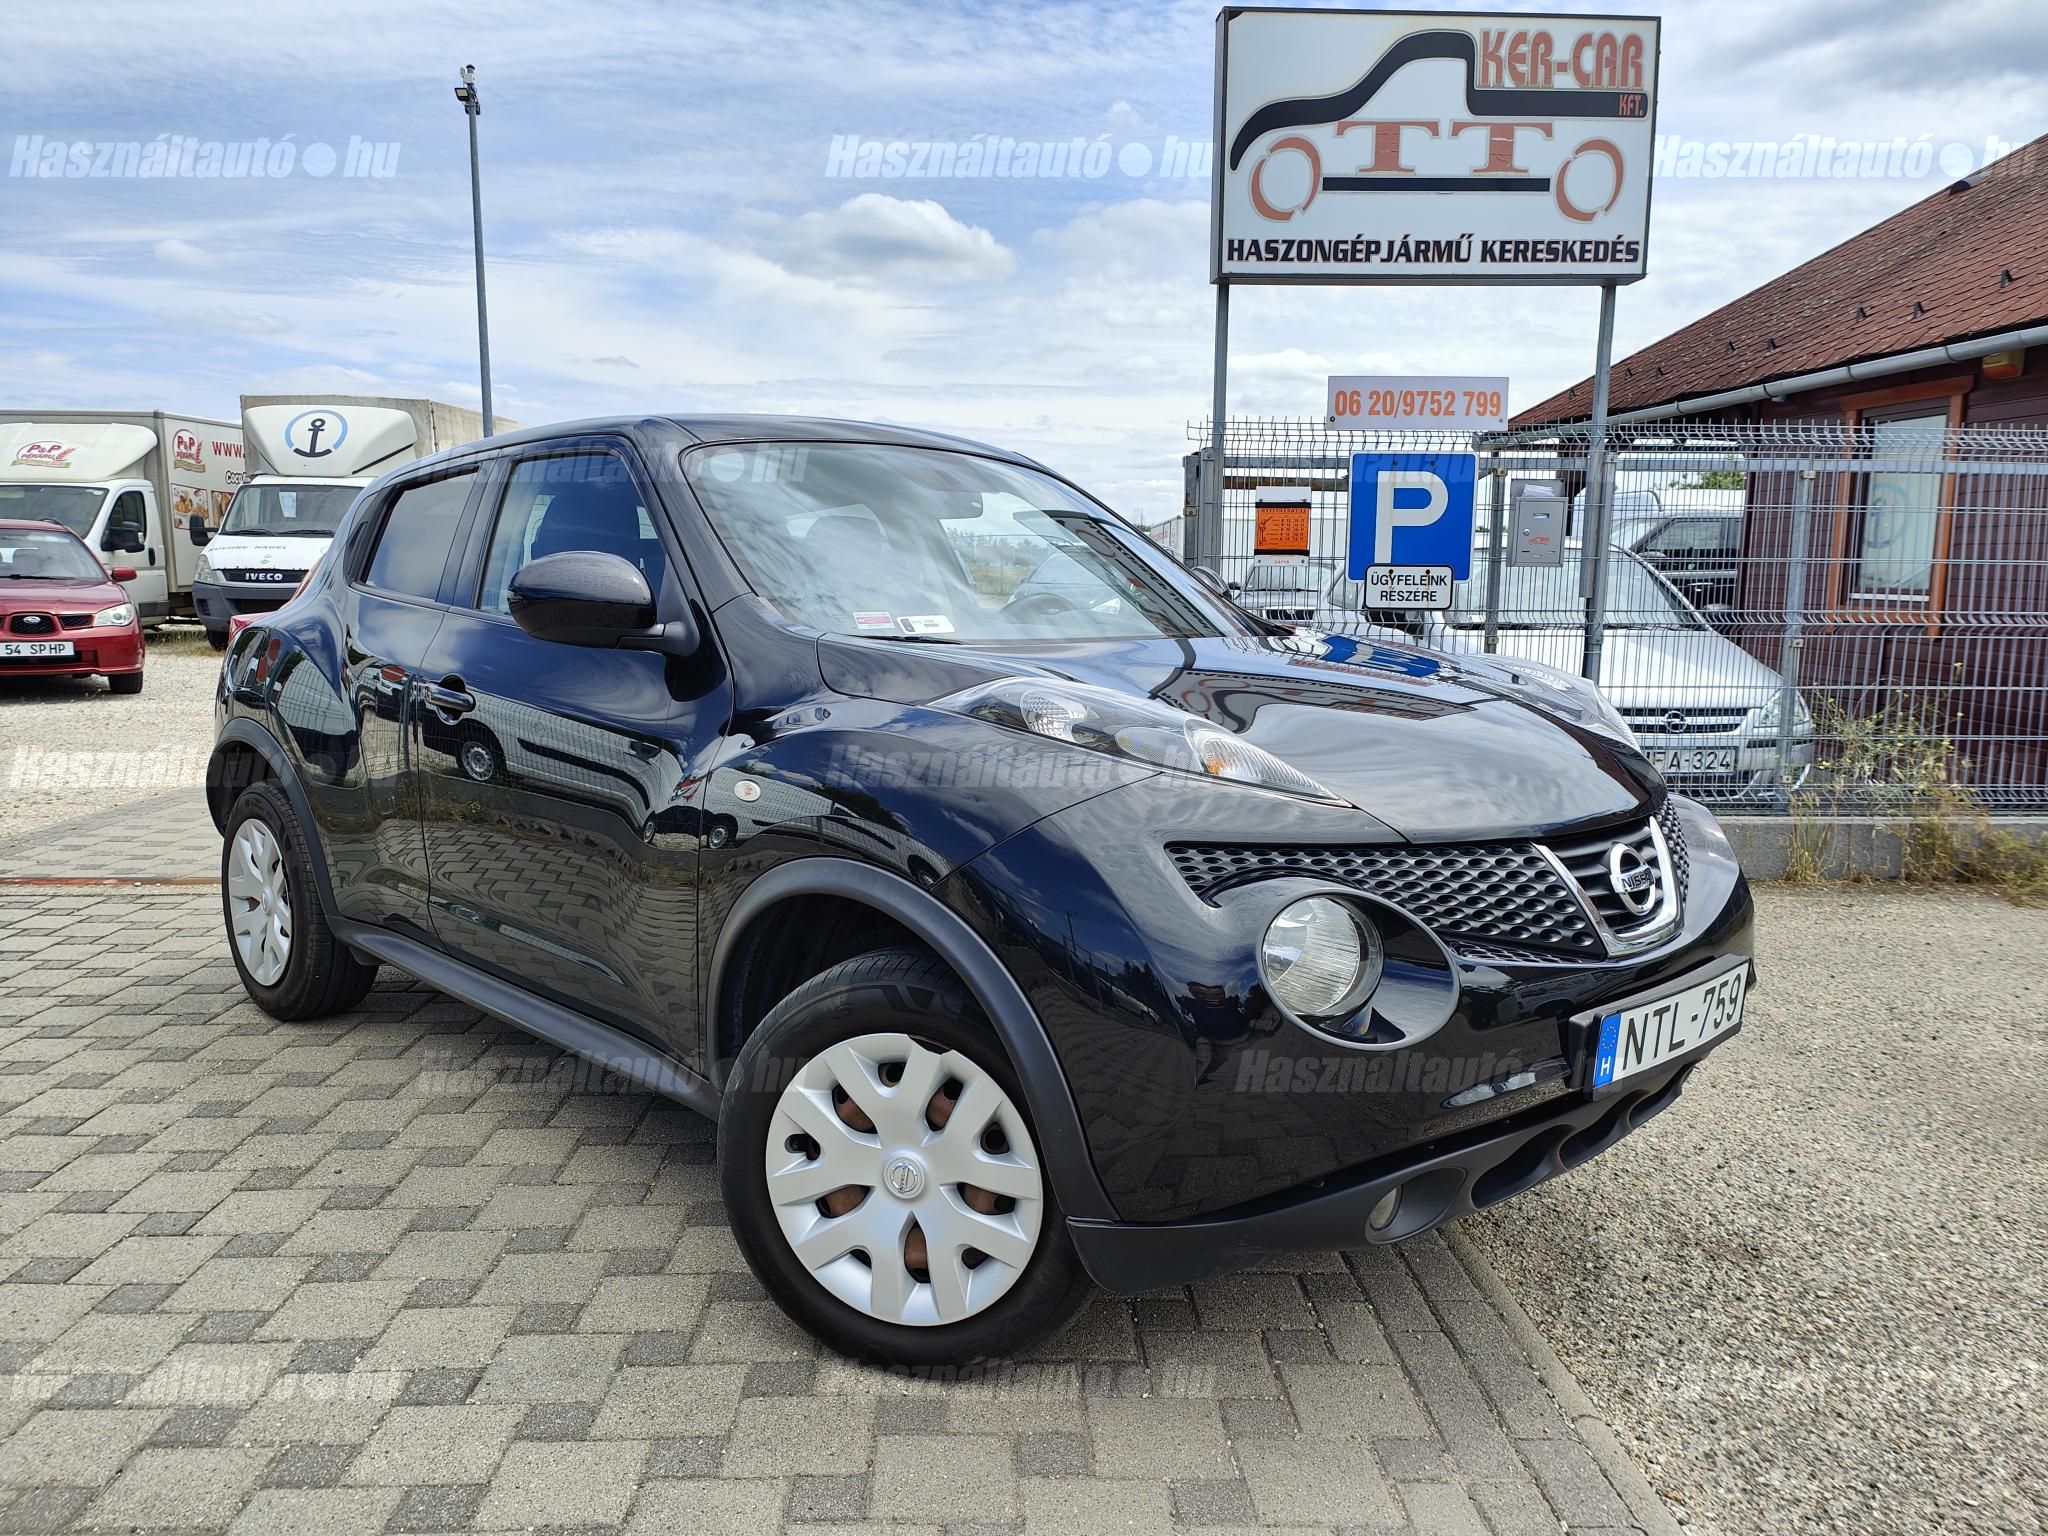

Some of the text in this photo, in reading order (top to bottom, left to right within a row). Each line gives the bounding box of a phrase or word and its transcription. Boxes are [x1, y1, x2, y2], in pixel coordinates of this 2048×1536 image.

[1480, 30, 1644, 88] KER-CAR
[1226, 233, 1641, 264] HASZONGÉPJÁRMŰ KERESKEDÉS
[1334, 389, 1502, 419] 06 20/9752 799
[245, 572, 283, 581] IVECO
[1371, 571, 1447, 586] ÜGYFELEINK
[1380, 587, 1437, 602] RÉSZÉRE
[5, 644, 21, 655] 54
[1622, 972, 1742, 1071] NTL-759
[1600, 1055, 1612, 1077] H
